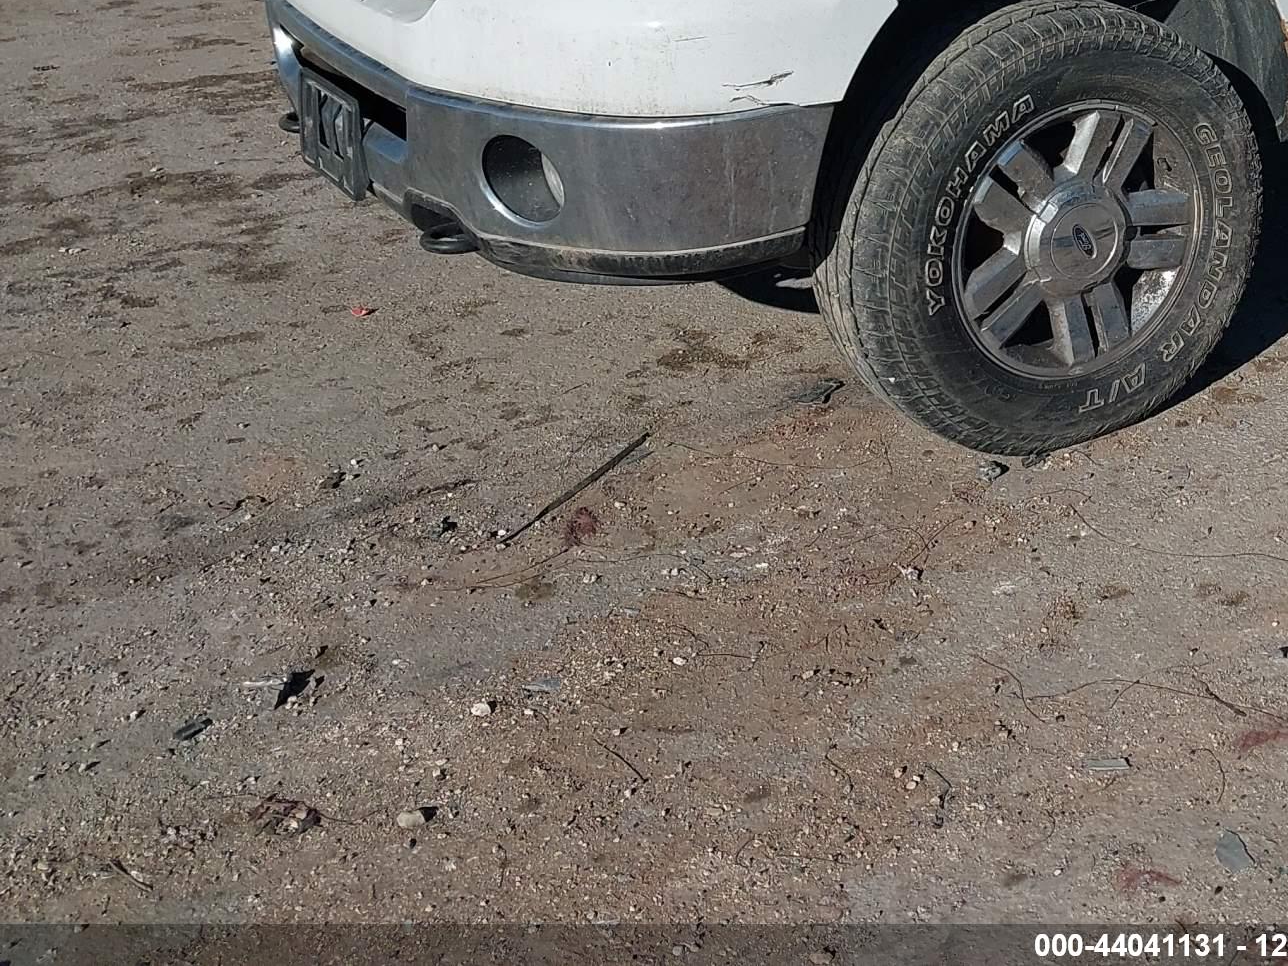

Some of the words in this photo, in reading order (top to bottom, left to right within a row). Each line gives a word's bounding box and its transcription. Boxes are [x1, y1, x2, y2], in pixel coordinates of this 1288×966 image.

[923, 94, 1036, 316] YOKOHAMA
[1158, 122, 1234, 362] GEOLANDAR
[1078, 362, 1146, 414] A/T
